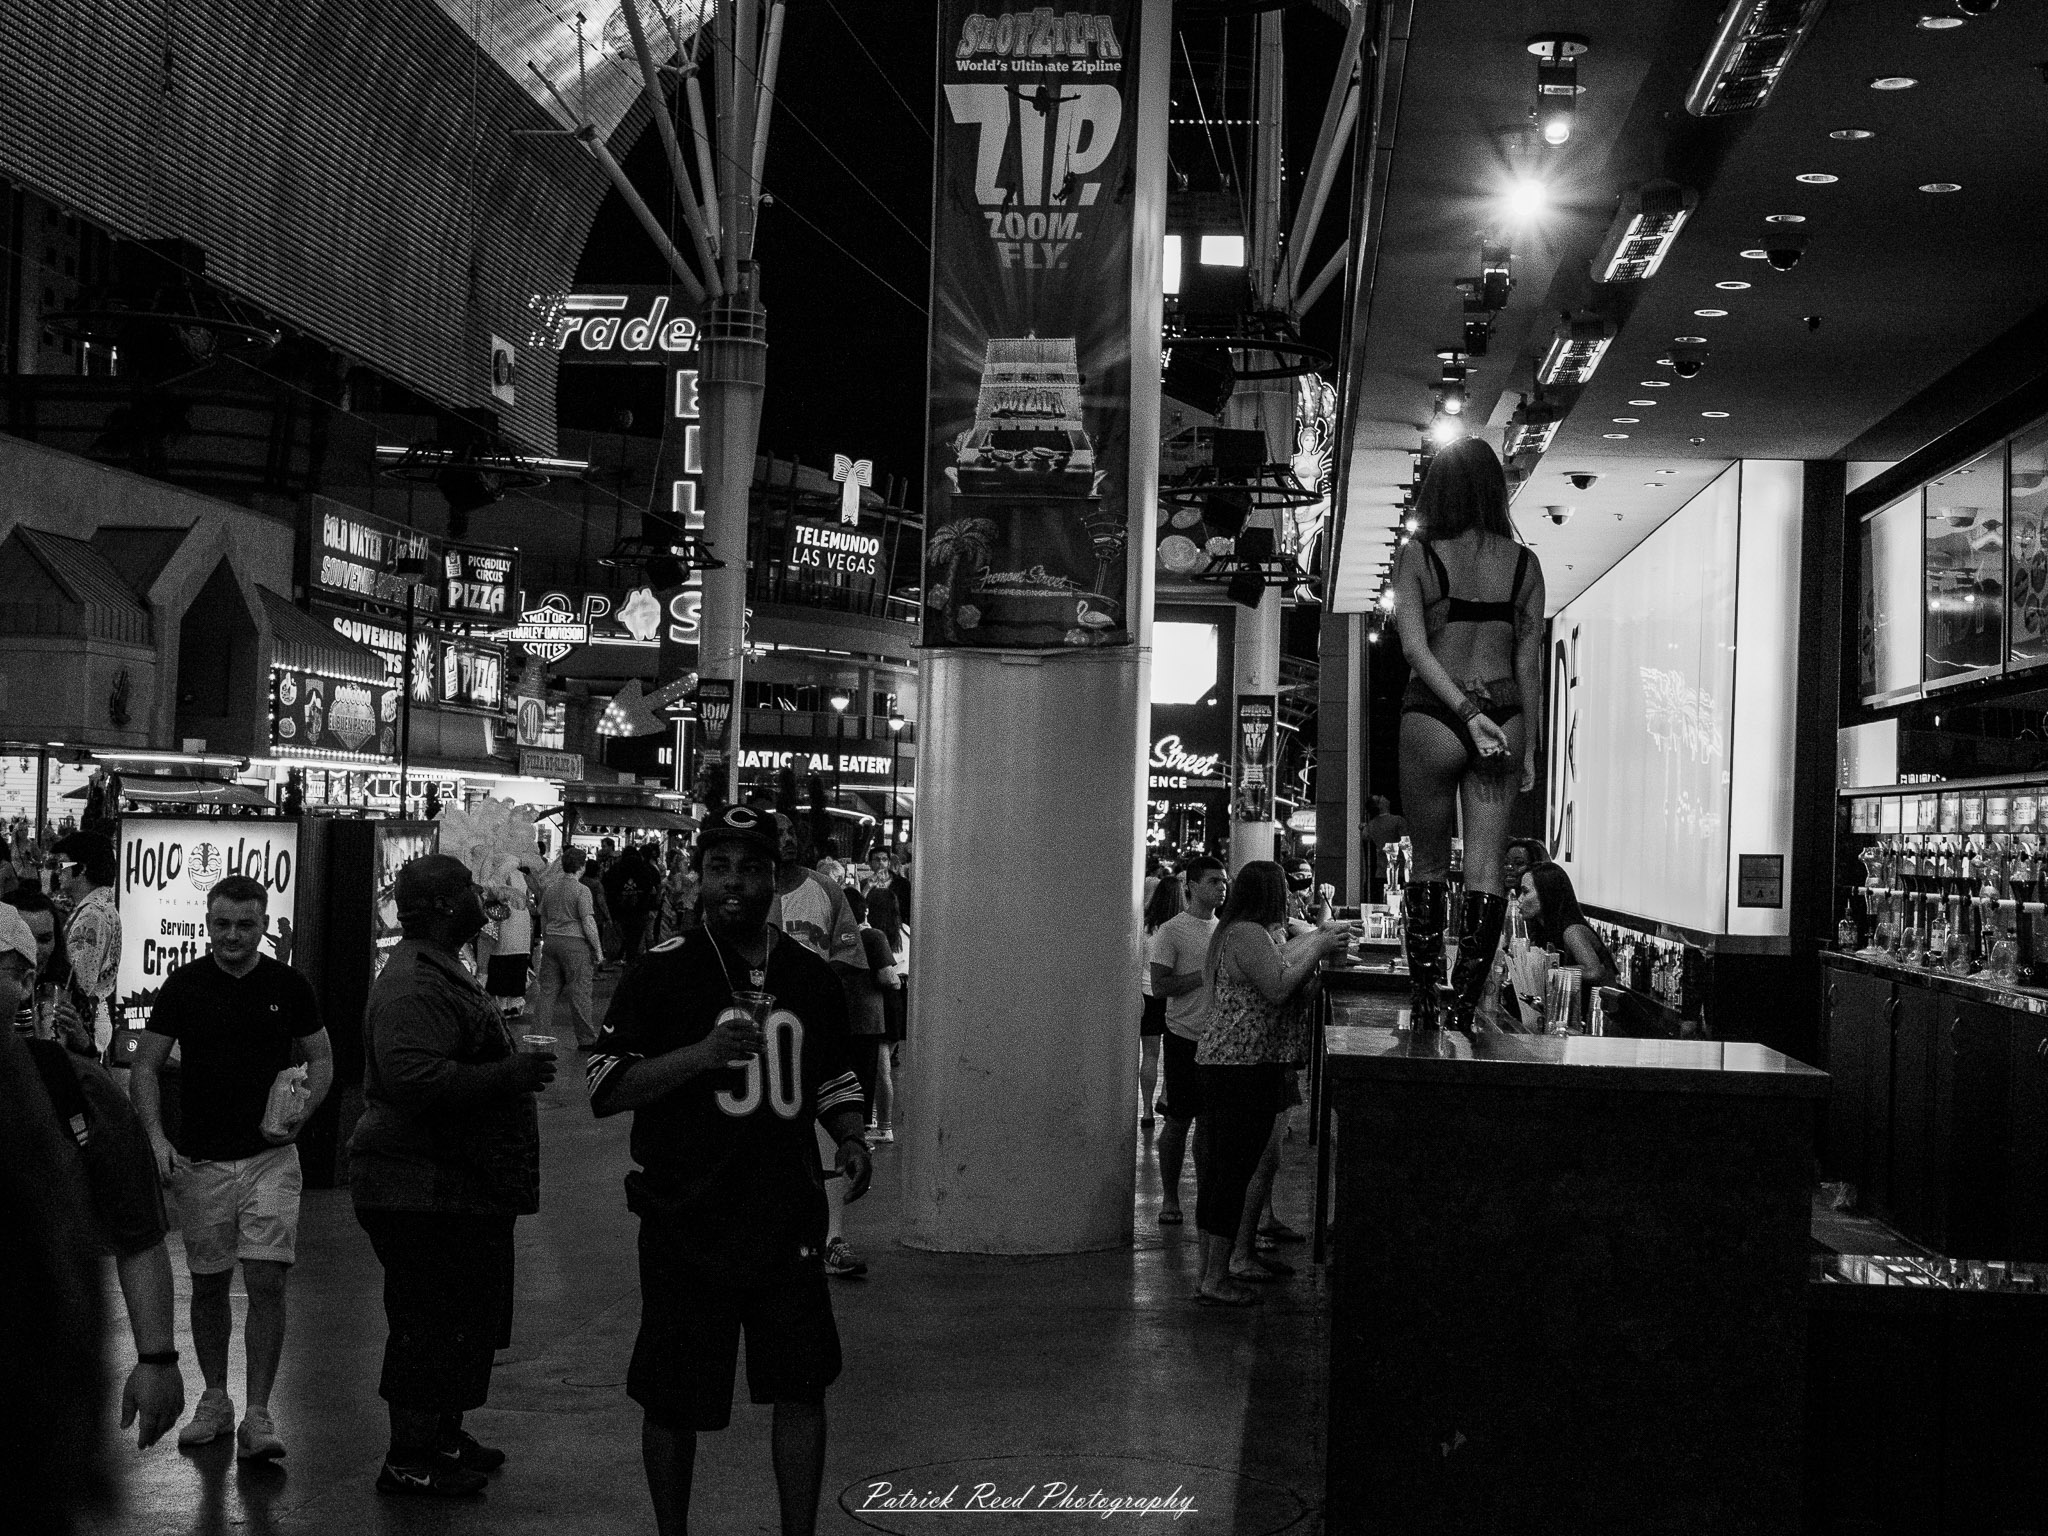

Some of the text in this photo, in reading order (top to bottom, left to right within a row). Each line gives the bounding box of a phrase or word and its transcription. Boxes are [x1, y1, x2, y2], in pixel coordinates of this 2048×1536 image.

[956, 7, 1122, 59] SLOTZILLA
[956, 60, 1122, 75] World's Ultimate Zipline
[983, 211, 1083, 240] ZOOM.
[996, 241, 1069, 269] FLY.
[527, 295, 698, 352] Trade
[323, 513, 348, 552] COLD
[348, 521, 383, 562] WATER
[795, 525, 880, 557] TELEMUNDO
[467, 555, 513, 574] PICCADILLY
[792, 546, 876, 576] LAS VEGAS
[475, 568, 505, 584] CIRCUS
[447, 579, 506, 614] PIZZA
[529, 610, 568, 624] MOTOR
[511, 626, 584, 641] HARLEY-DAVIDSON
[527, 642, 569, 661] CYCLES
[461, 653, 499, 702] PIZZA
[700, 702, 730, 720] JOIN
[702, 719, 725, 731] THE
[839, 754, 891, 775] EATERY
[1149, 734, 1219, 777] Street
[126, 837, 291, 895] HOLO HOLO
[161, 918, 196, 939] Serving
